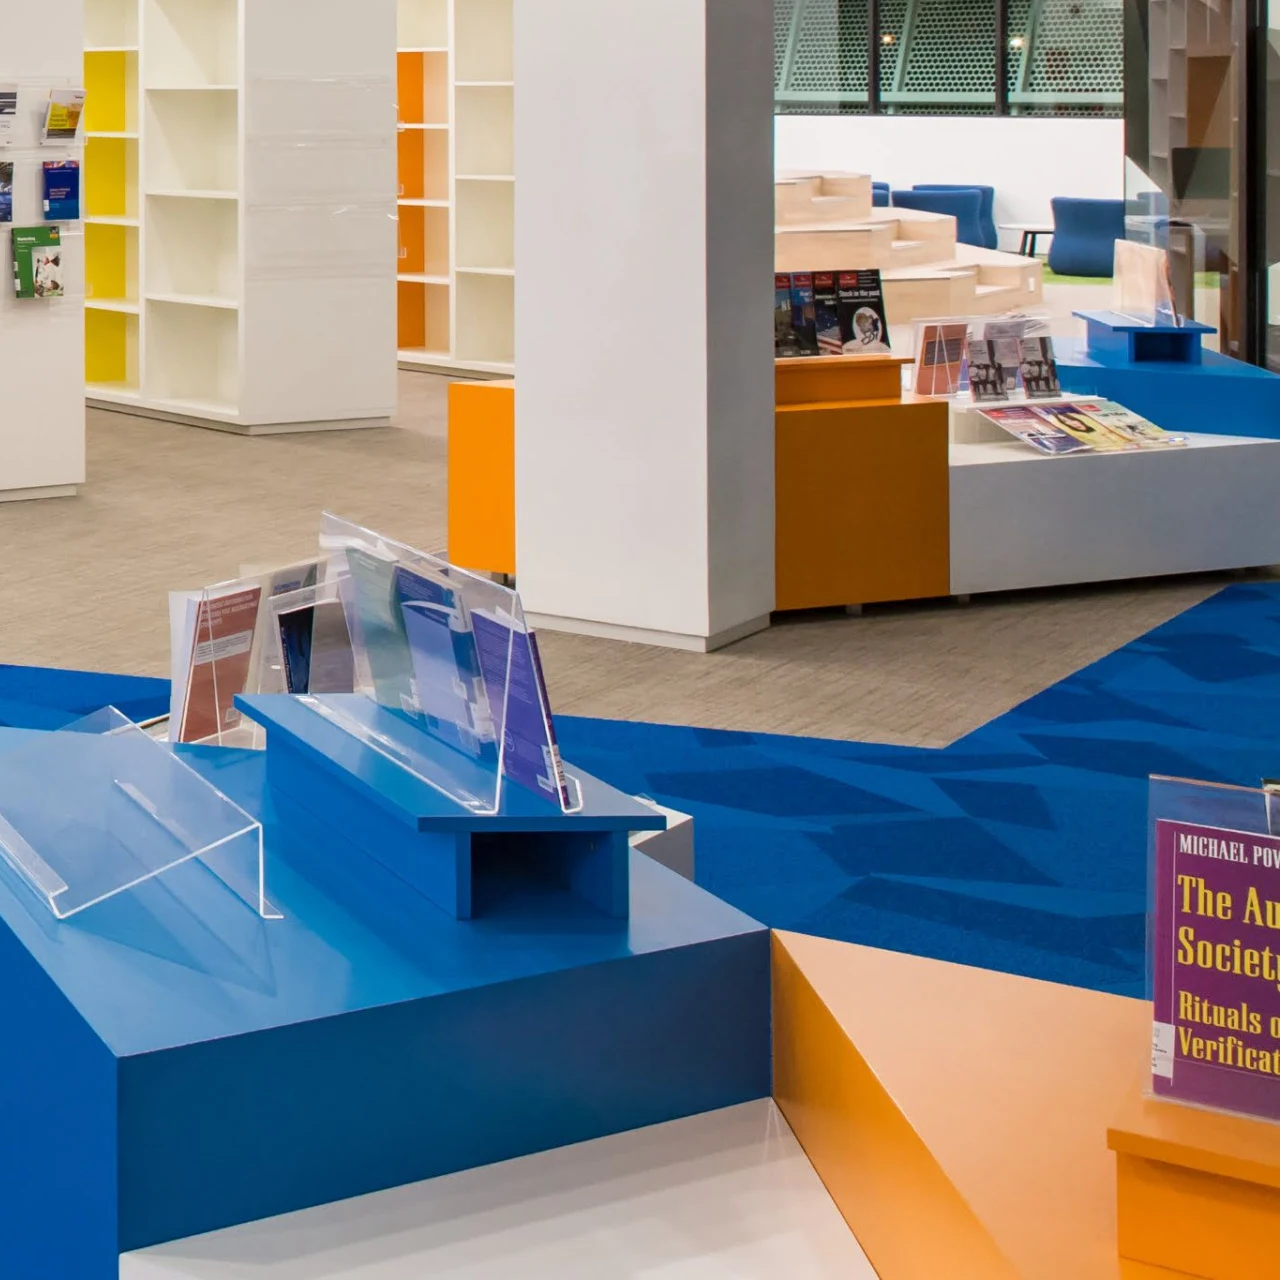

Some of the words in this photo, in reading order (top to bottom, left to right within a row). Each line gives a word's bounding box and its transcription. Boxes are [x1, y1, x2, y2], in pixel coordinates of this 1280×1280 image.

[1180, 833, 1248, 864] MICHAEL
[1177, 874, 1232, 920] The
[1243, 886, 1280, 930] Au
[1178, 990, 1262, 1034] Rituals
[1178, 1026, 1280, 1075] Verificat
